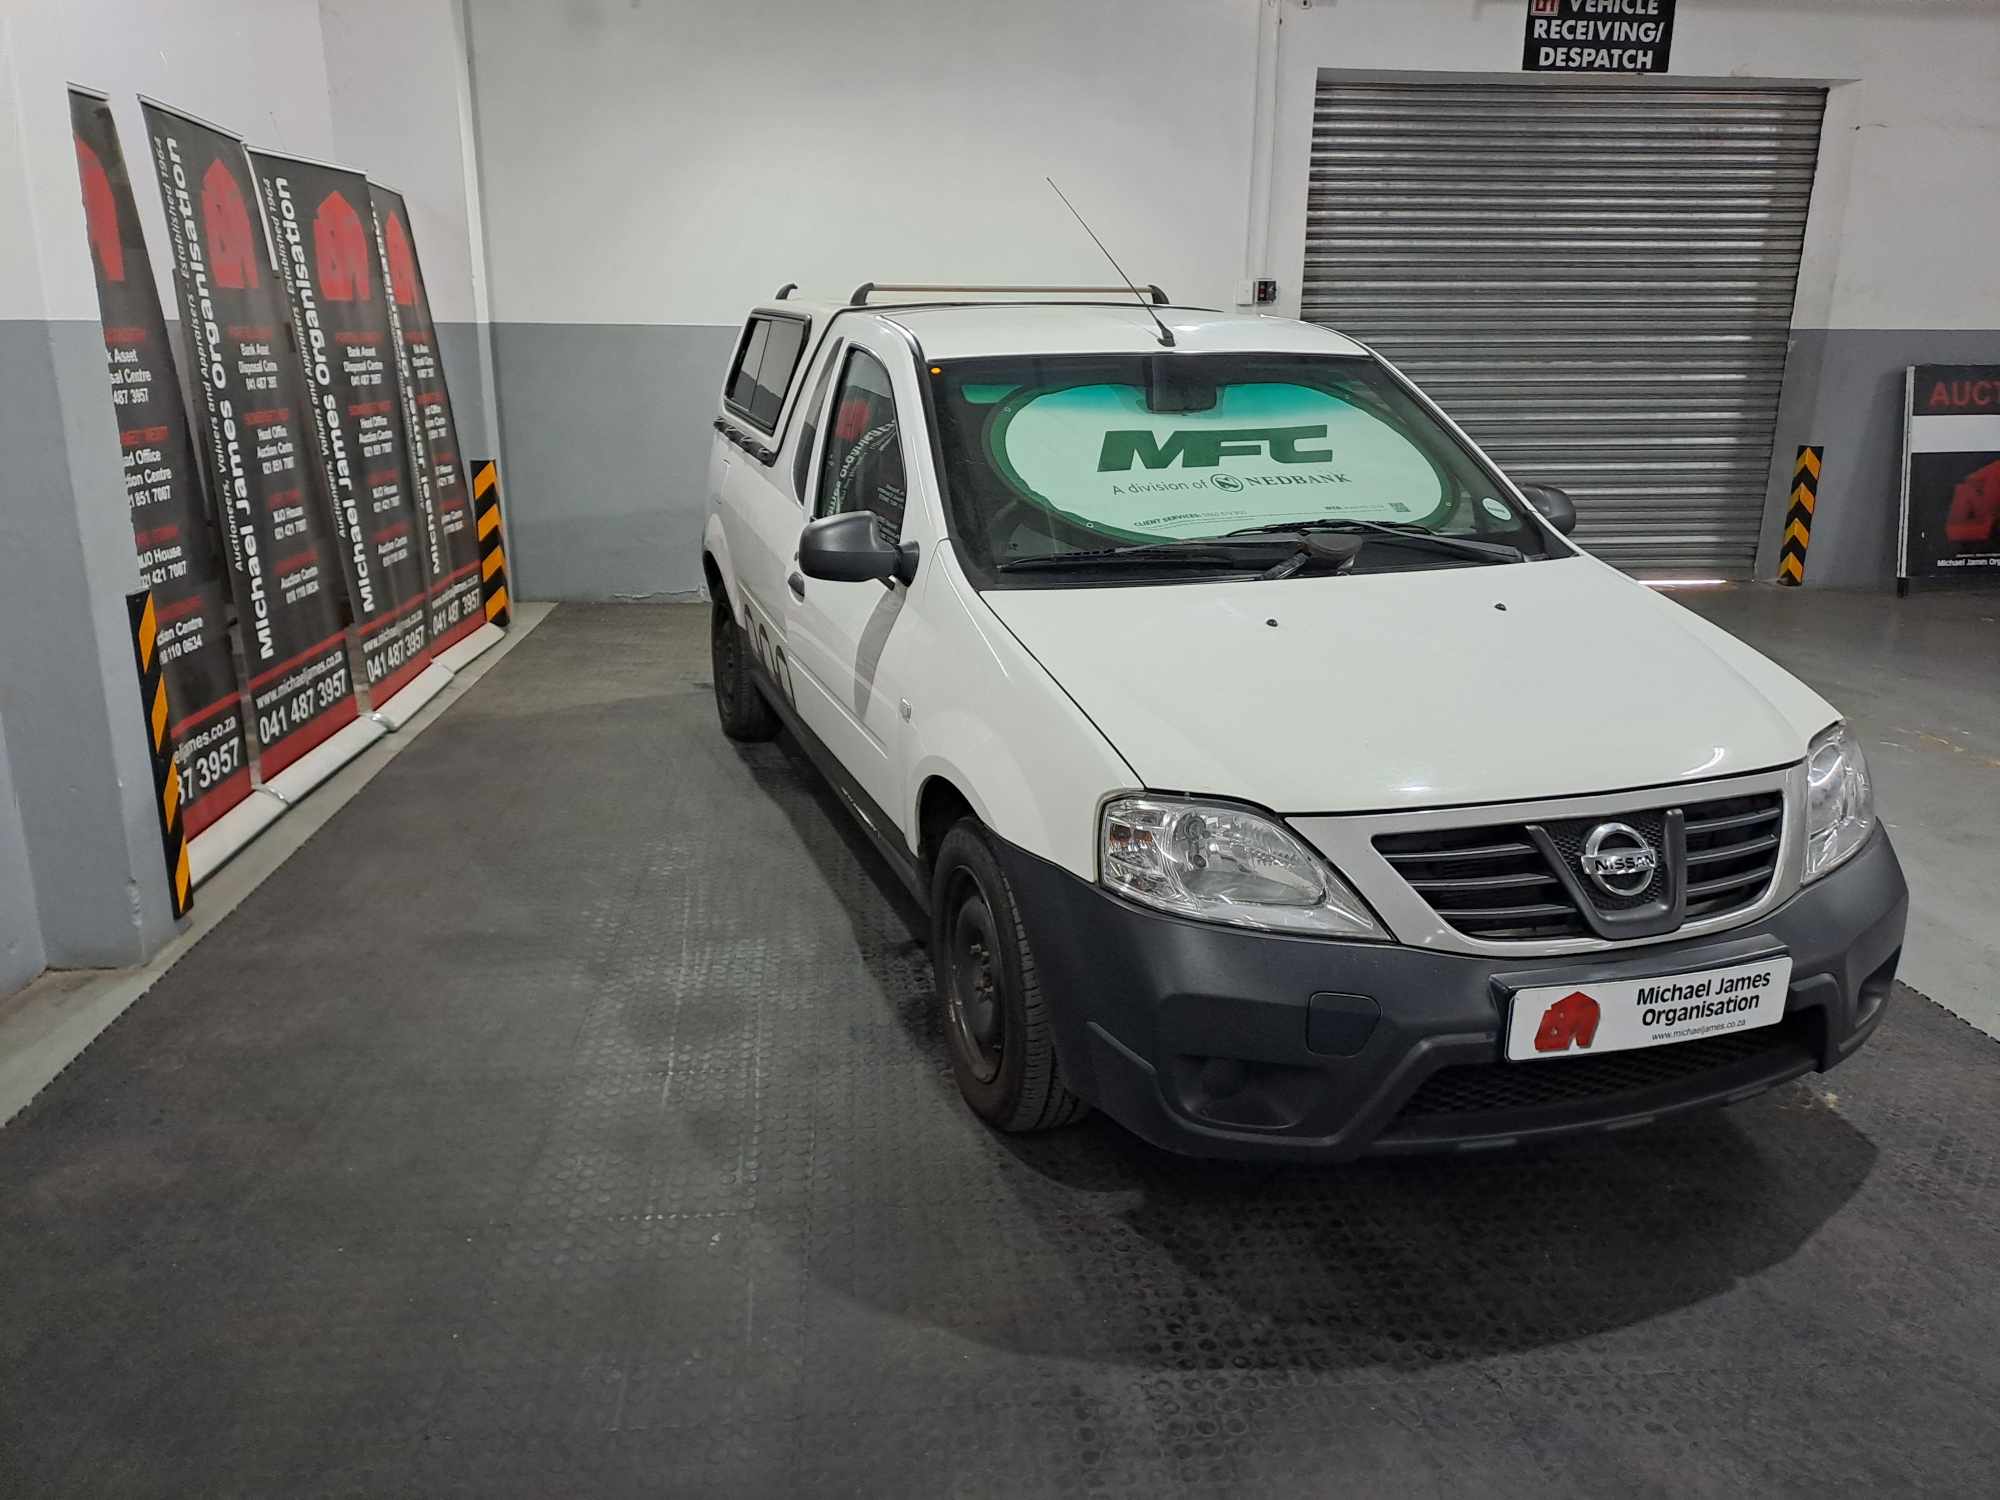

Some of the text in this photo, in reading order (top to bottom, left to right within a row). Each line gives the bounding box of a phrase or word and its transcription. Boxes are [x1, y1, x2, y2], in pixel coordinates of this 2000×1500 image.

[1570, 0, 1659, 15] VEHICLE
[1533, 18, 1665, 43] RECEIVING/
[1539, 46, 1653, 69] DESPATCH
[166, 136, 274, 661] Michael James Organisation
[275, 177, 375, 613] Michael James Organisation
[1096, 424, 1333, 473] MFC
[1112, 473, 1351, 496] A division of NEDBANK
[420, 475, 441, 575] Michael
[432, 588, 480, 636] 041 487 3957
[366, 624, 425, 682] 041 487 3957
[259, 667, 346, 744] 041 487 3957
[196, 736, 240, 788] 3957
[1595, 855, 1654, 871] NISSAN
[1636, 971, 1771, 1006] Michael James
[1641, 993, 1761, 1026] Organisation
[1651, 1019, 1746, 1041] www.michaeljames.co.za
